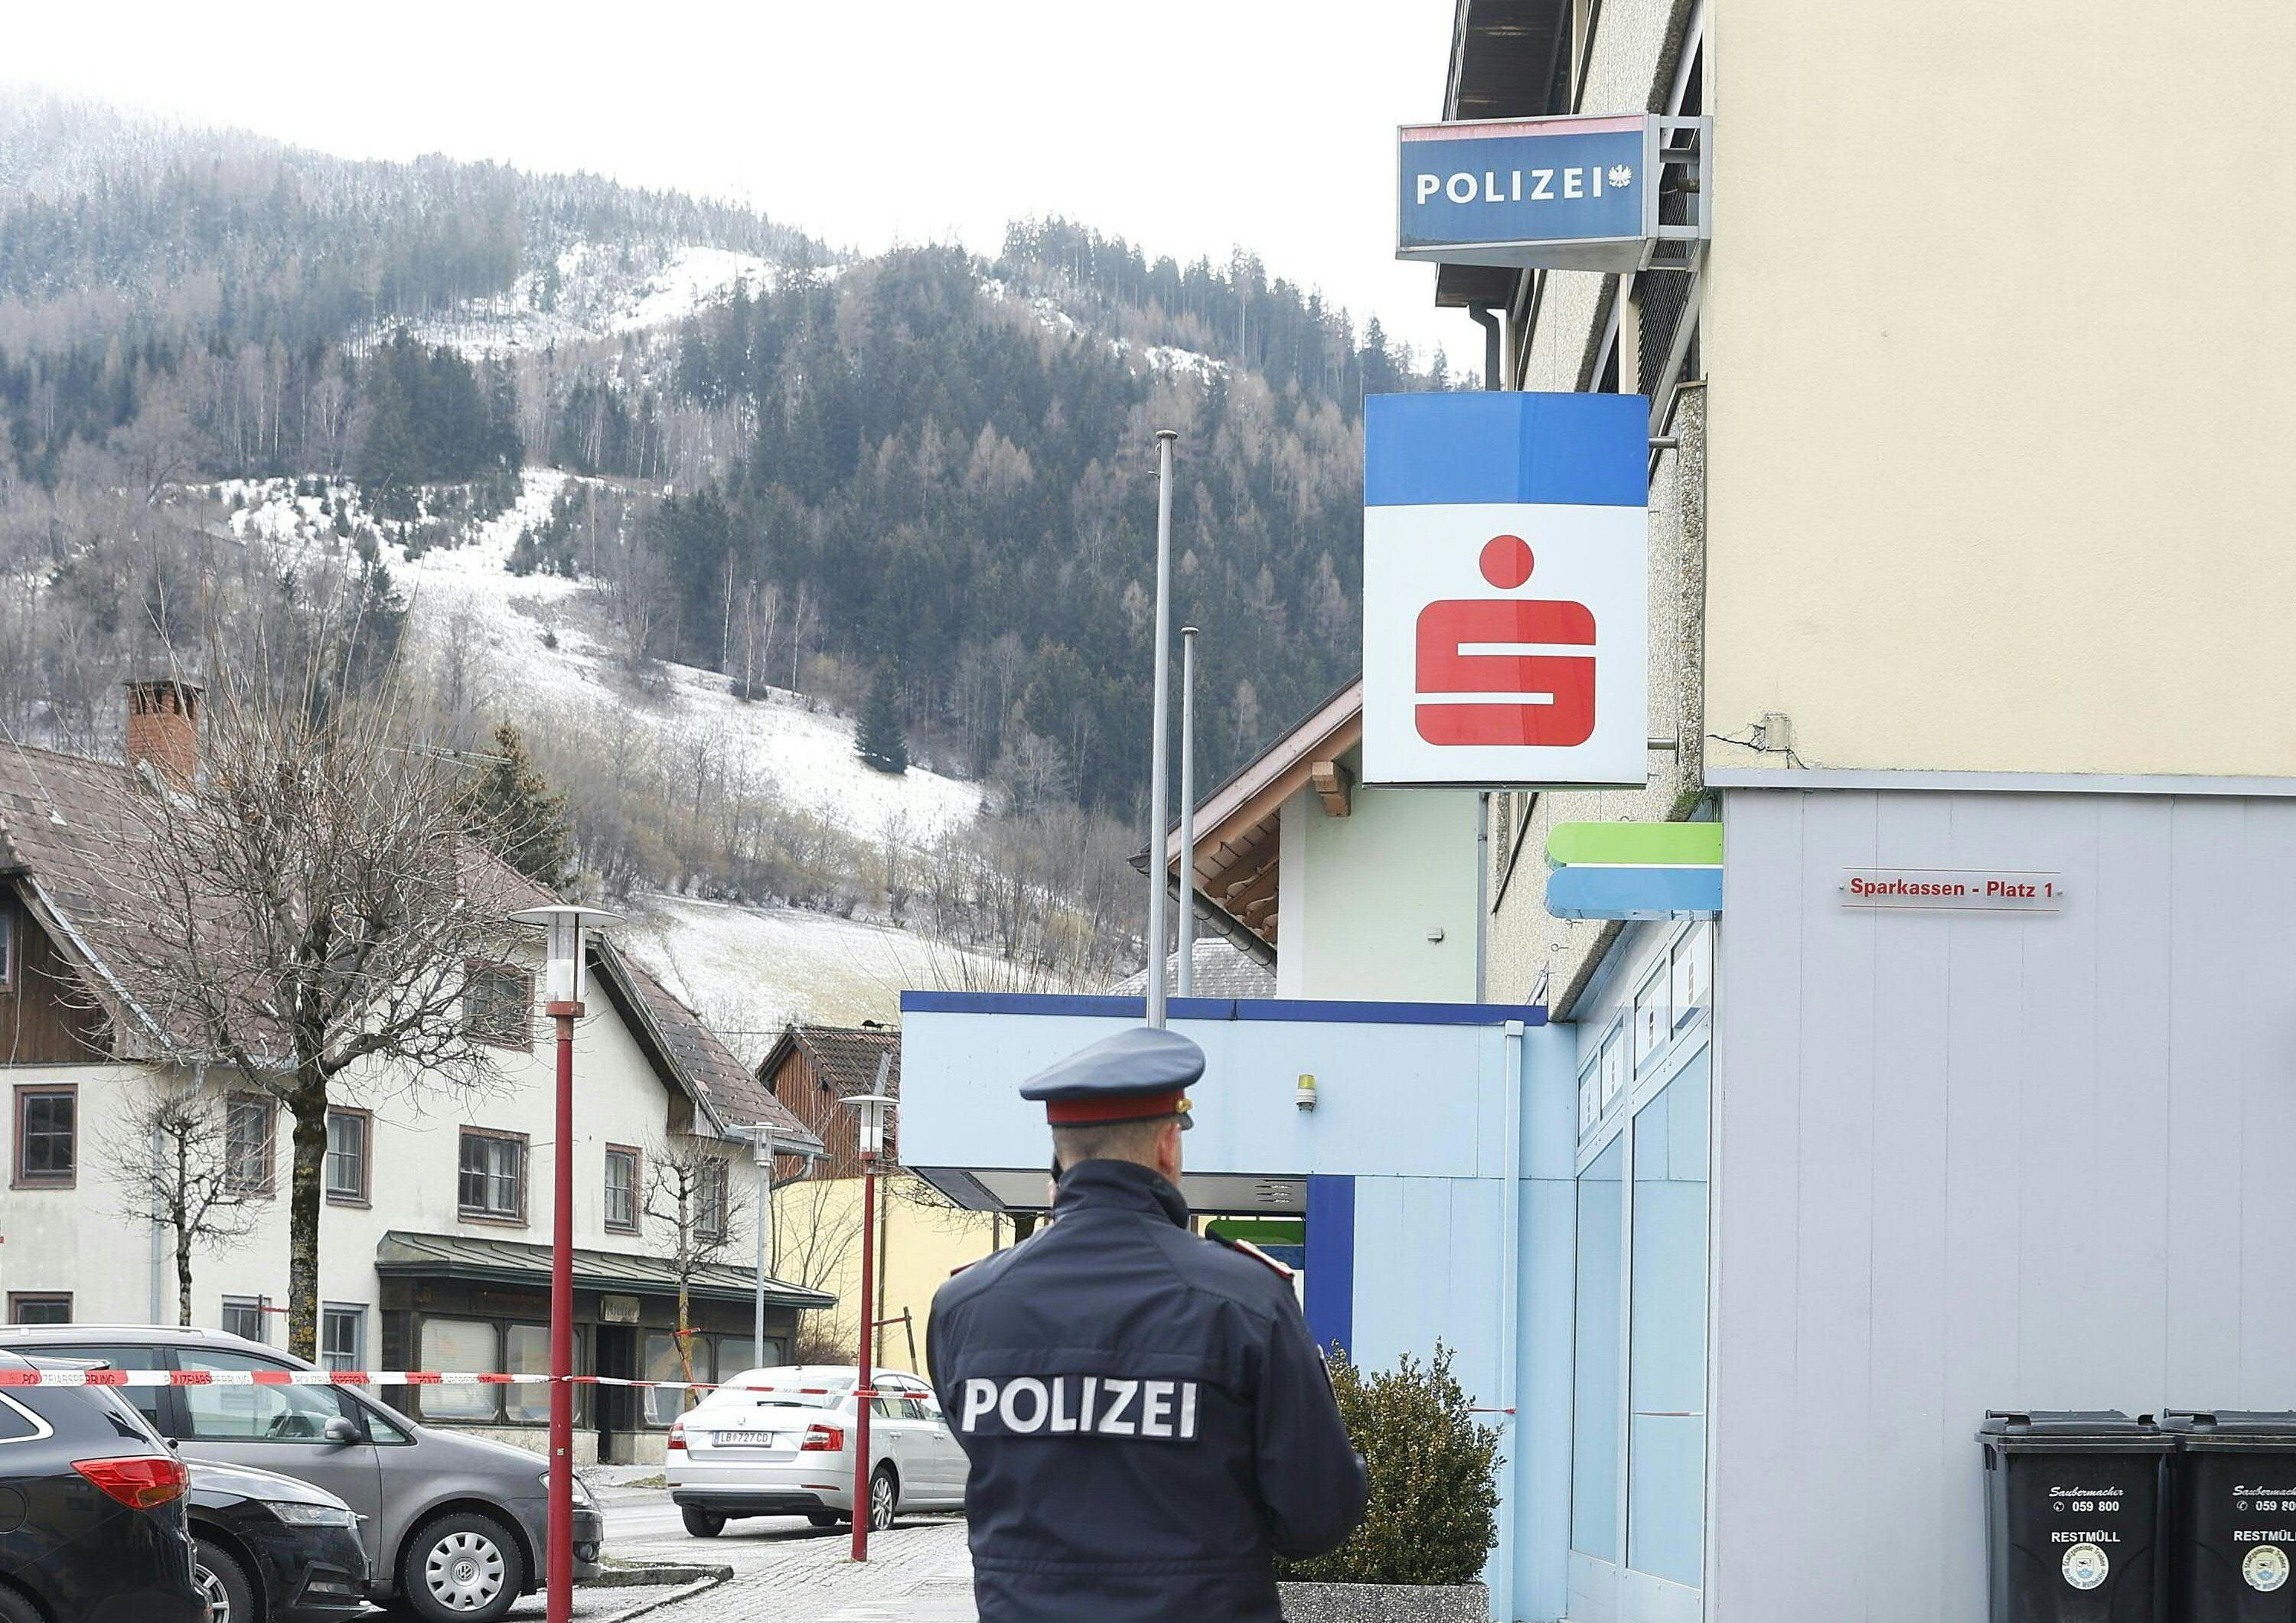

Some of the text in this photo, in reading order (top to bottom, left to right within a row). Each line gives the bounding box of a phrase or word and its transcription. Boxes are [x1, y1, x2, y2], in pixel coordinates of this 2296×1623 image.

[1417, 167, 1602, 205] POLIZEI
[1851, 878, 1965, 898] Sparkassen
[1987, 880, 2036, 898] Platz
[2044, 882, 2053, 898] 1
[961, 1377, 1198, 1438] POLIZEI
[721, 1432, 732, 1442] LB
[738, 1433, 754, 1442] 727
[2049, 1486, 2125, 1497] Saubermacher
[2072, 1501, 2120, 1512] 059 800
[2255, 1501, 2296, 1511] 059 80
[2051, 1530, 2121, 1543] RESTMÜLL
[2233, 1529, 2296, 1542] RESTMÜL
